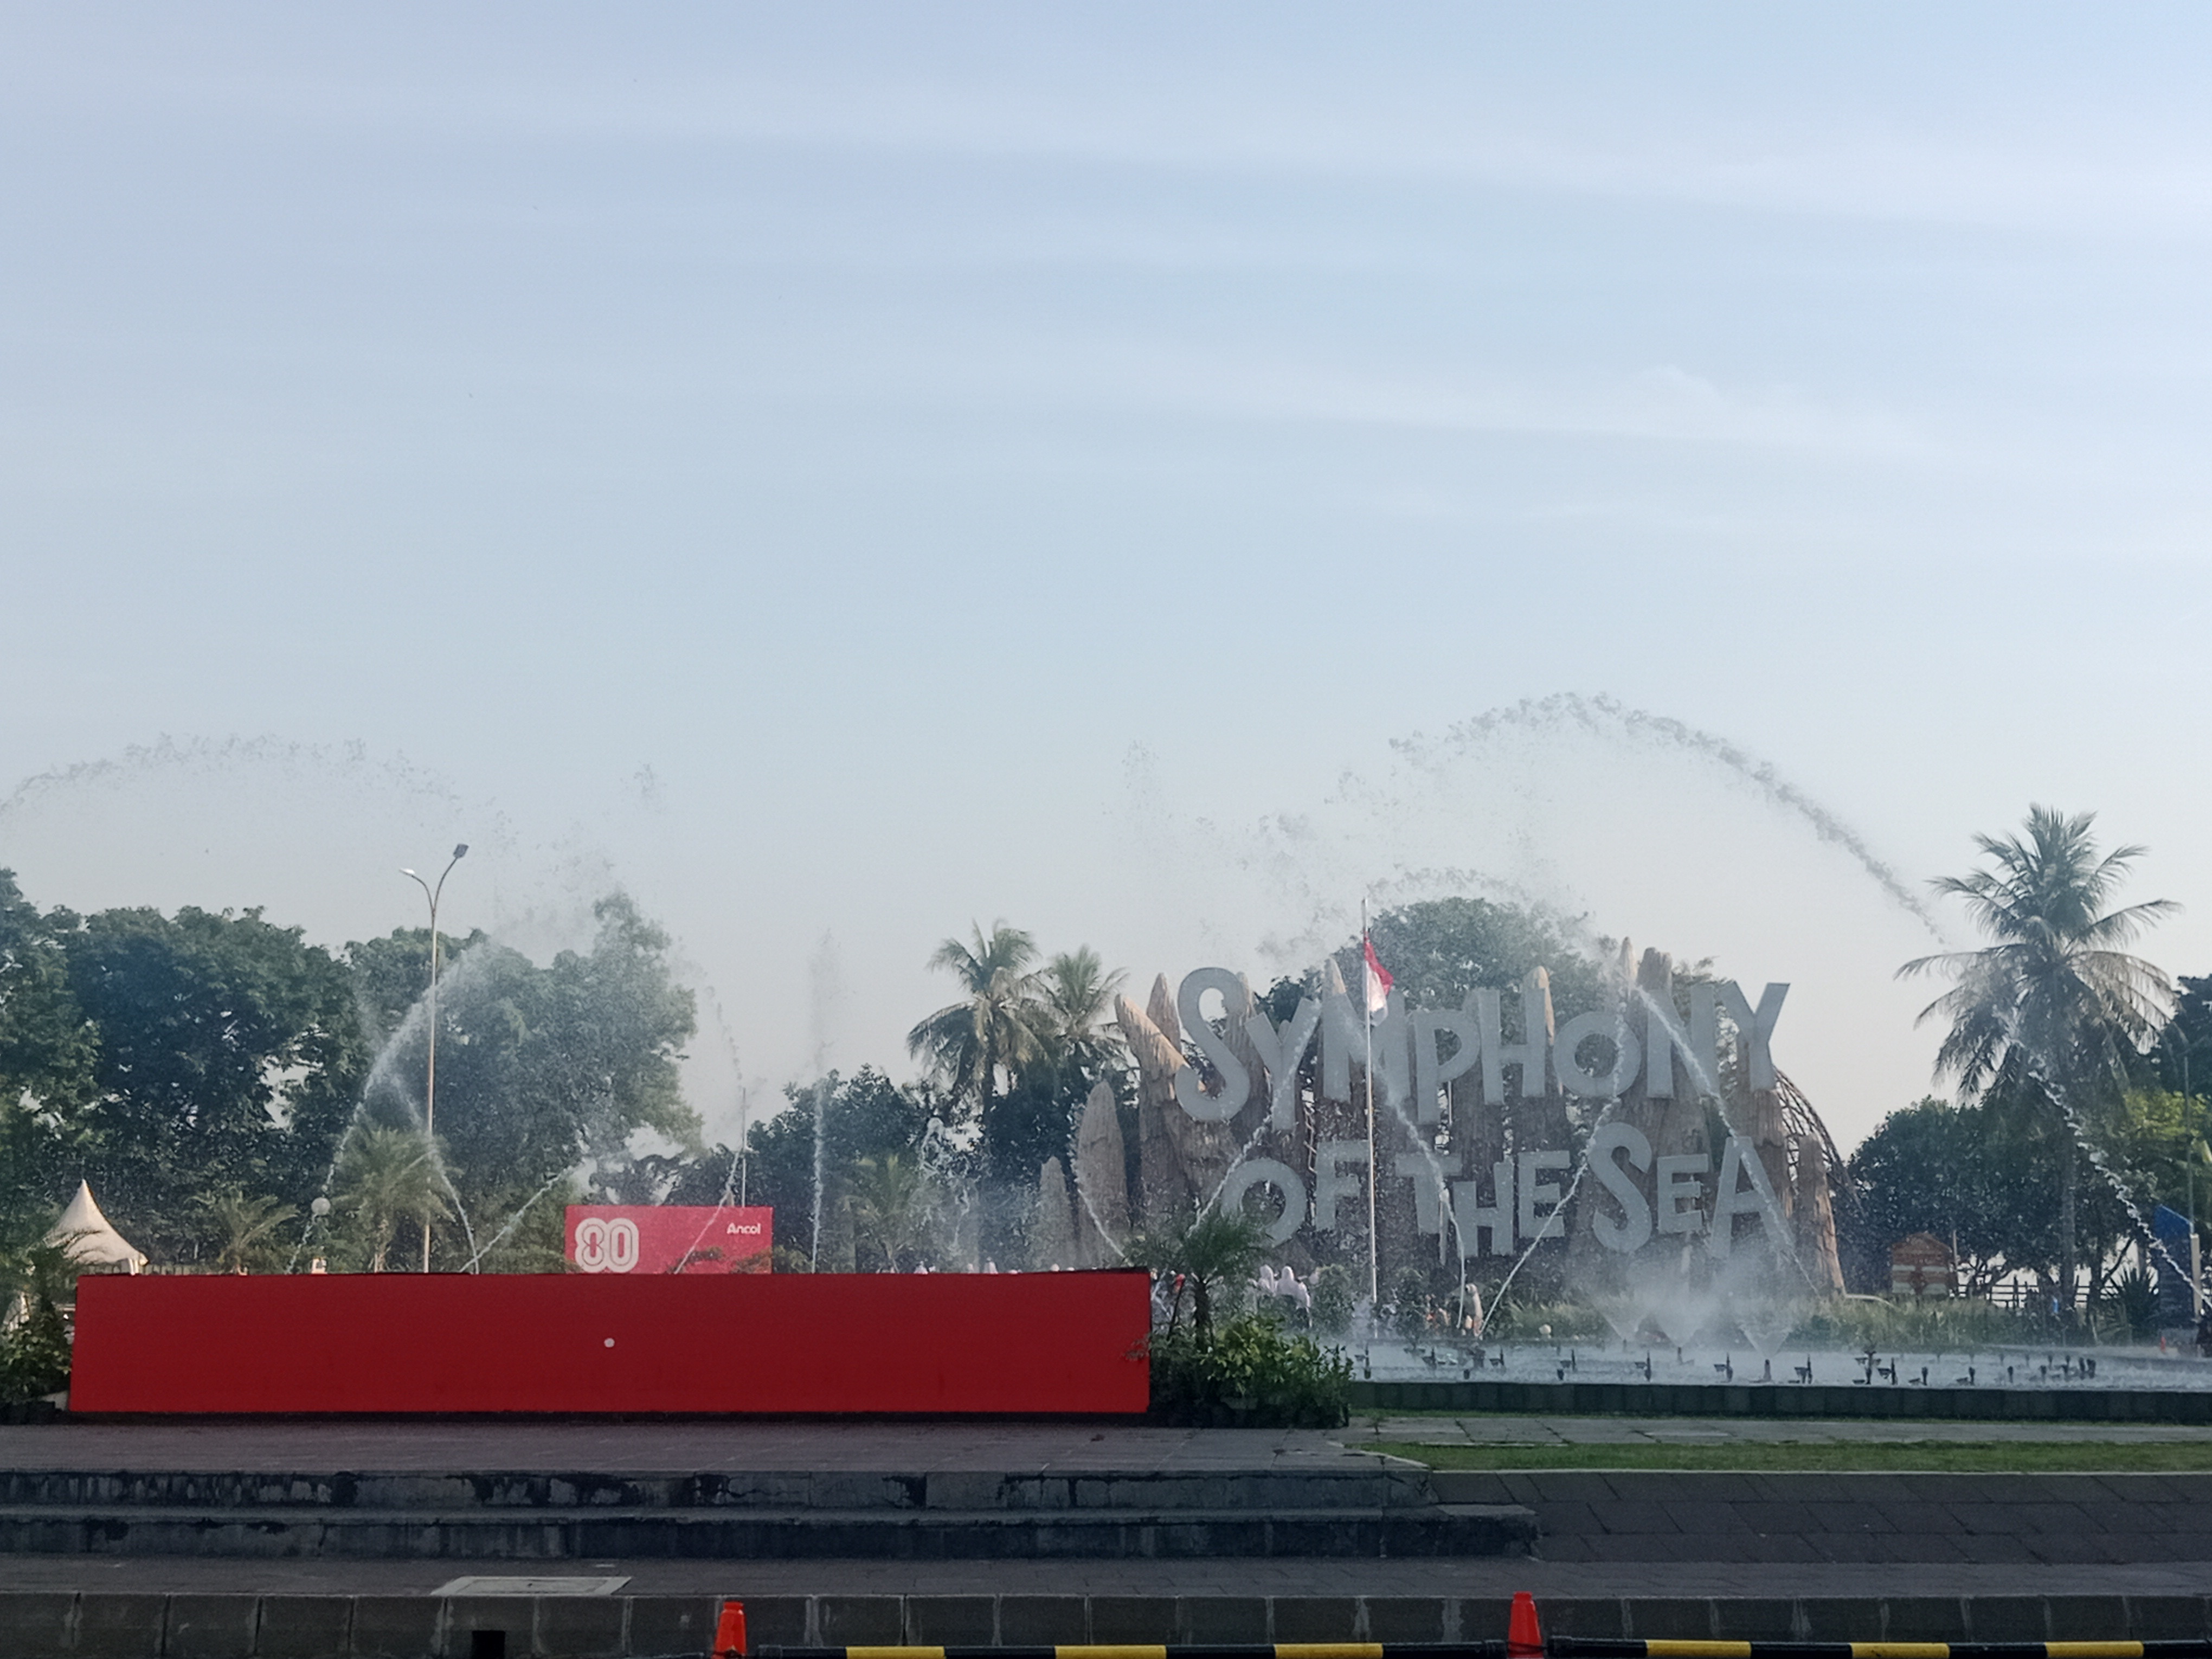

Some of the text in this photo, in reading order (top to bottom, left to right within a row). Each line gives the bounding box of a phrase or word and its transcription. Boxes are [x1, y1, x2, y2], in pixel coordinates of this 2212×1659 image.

[1174, 967, 1791, 1130] SYMPHONY
[726, 1222, 761, 1235] Ancol
[1220, 1122, 1797, 1259] OF THE SEA
[575, 1217, 639, 1273] 80
